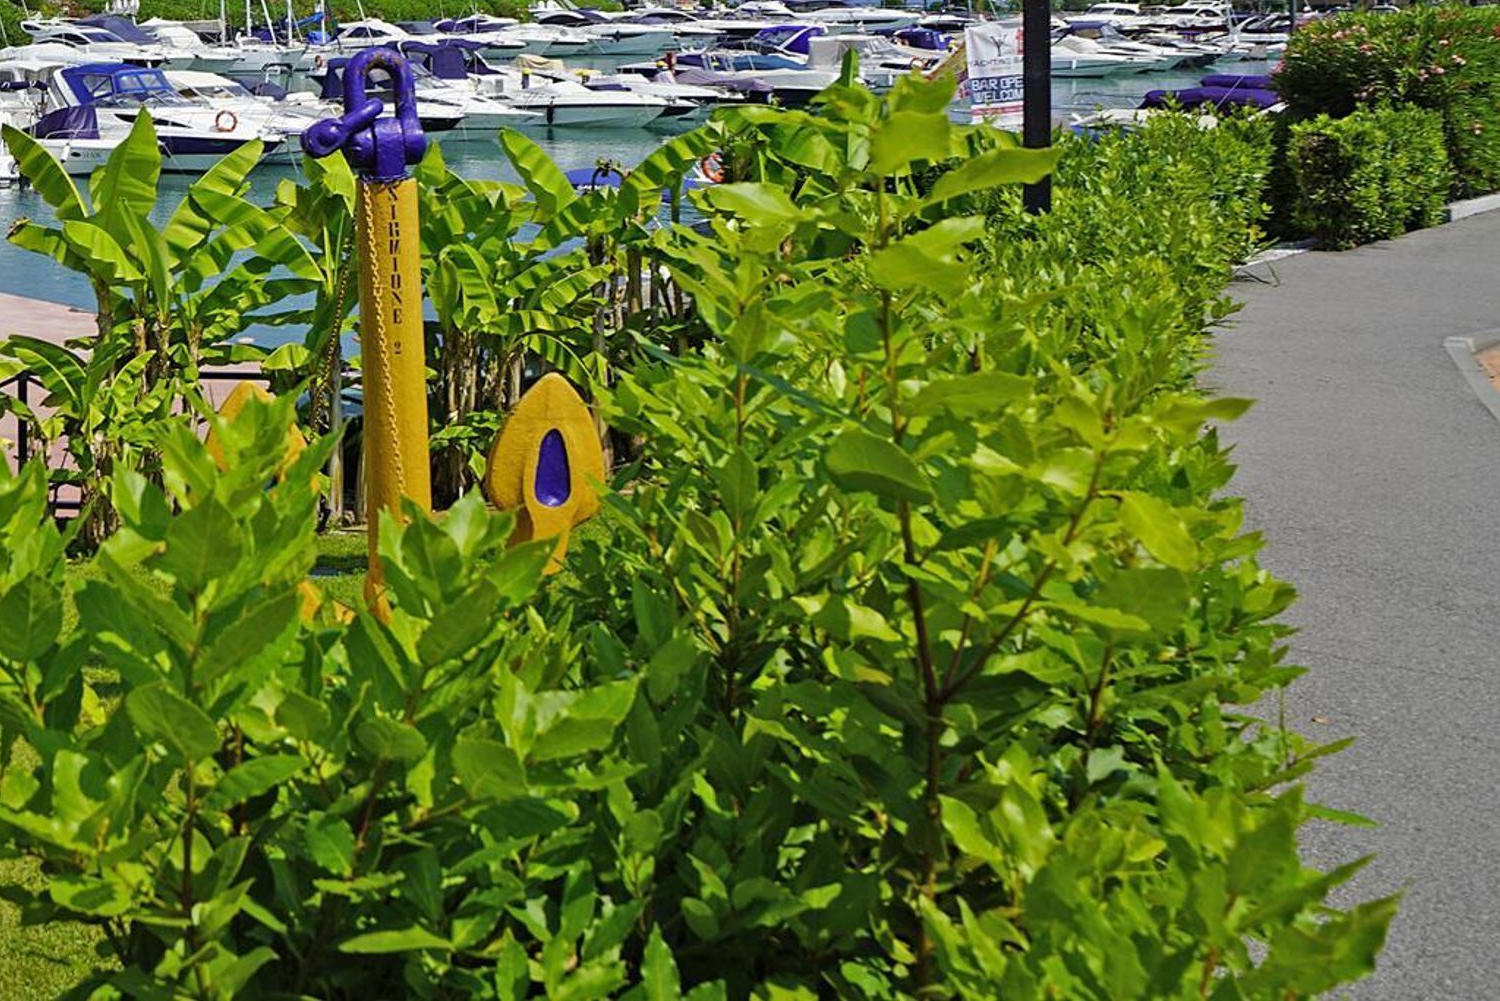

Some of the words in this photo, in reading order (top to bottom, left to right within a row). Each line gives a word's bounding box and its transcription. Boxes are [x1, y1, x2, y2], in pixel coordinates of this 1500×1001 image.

[971, 79, 998, 91] BAR
[1000, 77, 1023, 89] OPE
[972, 89, 1023, 102] WELCOM
